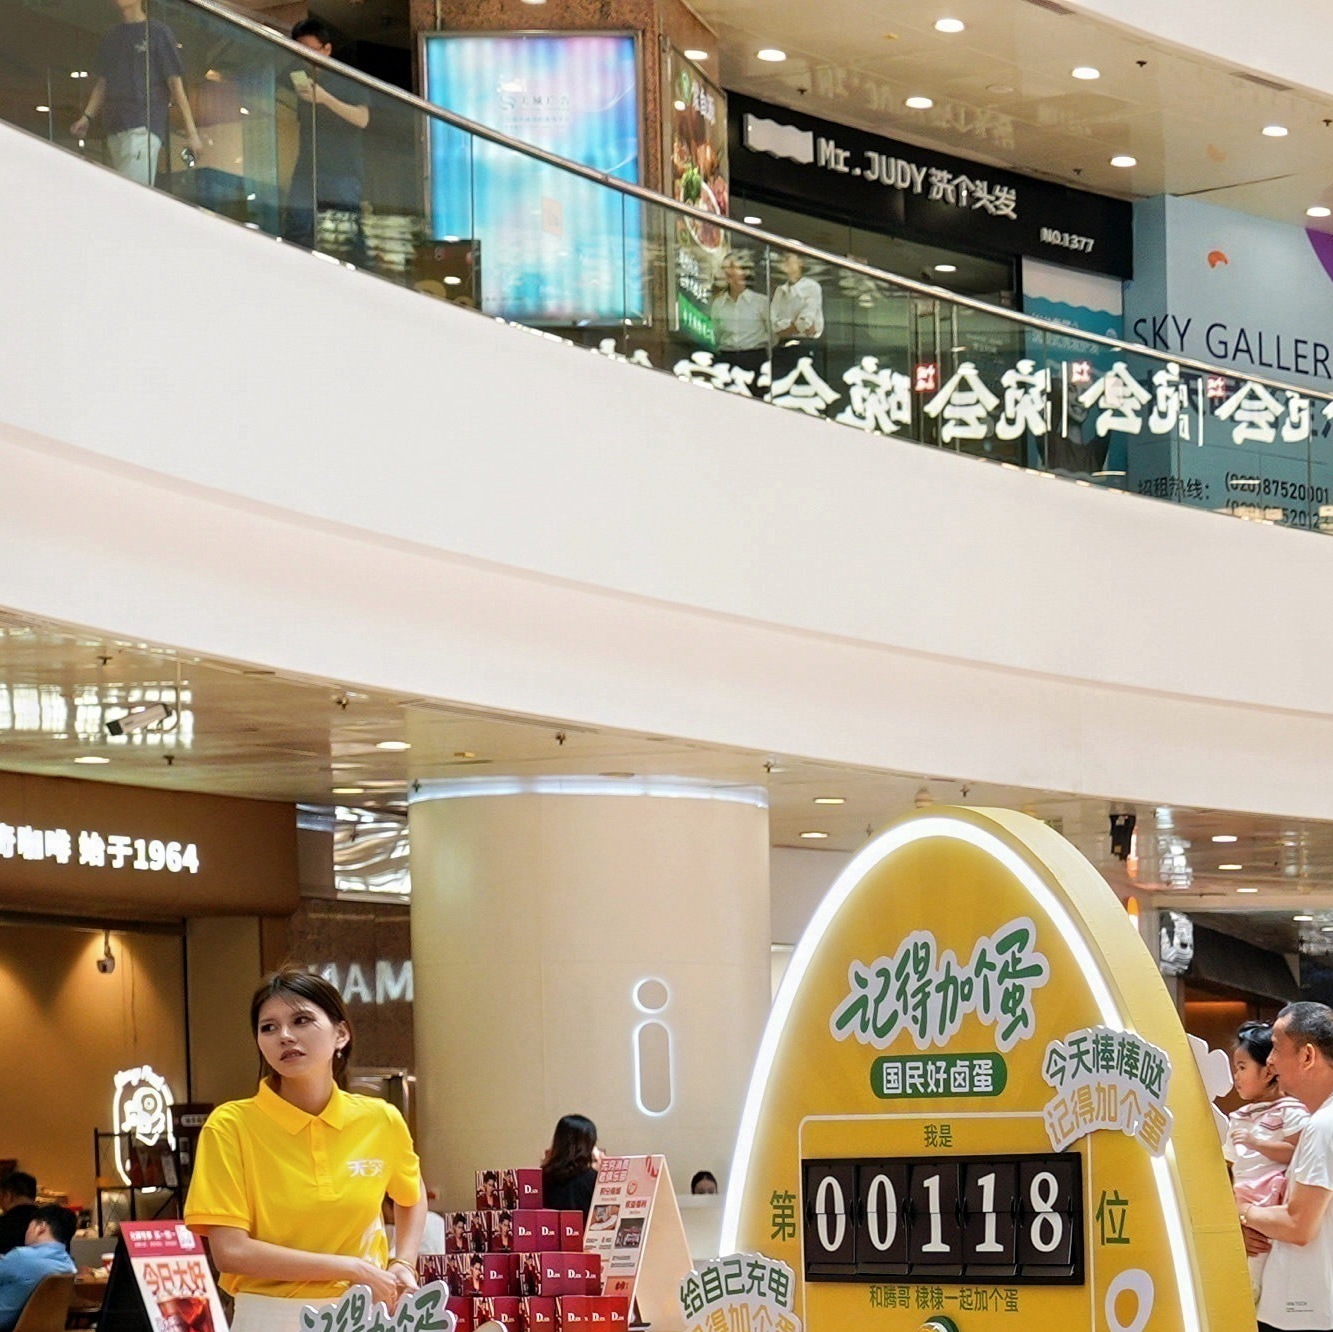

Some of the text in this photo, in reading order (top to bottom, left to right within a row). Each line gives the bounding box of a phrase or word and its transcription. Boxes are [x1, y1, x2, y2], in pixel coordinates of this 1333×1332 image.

[927, 166, 1018, 220] 洗个头发
[1133, 313, 1192, 353] SKY
[78, 834, 200, 875] 始于1964
[836, 926, 1043, 1043] 记得加个蛋
[882, 1060, 994, 1095] 国民好卤蛋
[1045, 1032, 1166, 1100] 今天棒棒哒
[923, 1124, 953, 1149] 我是
[1048, 1079, 1167, 1156] 记得加个蛋
[769, 1172, 1131, 1253] 第 00118 位
[680, 1259, 789, 1320] 给自己充电
